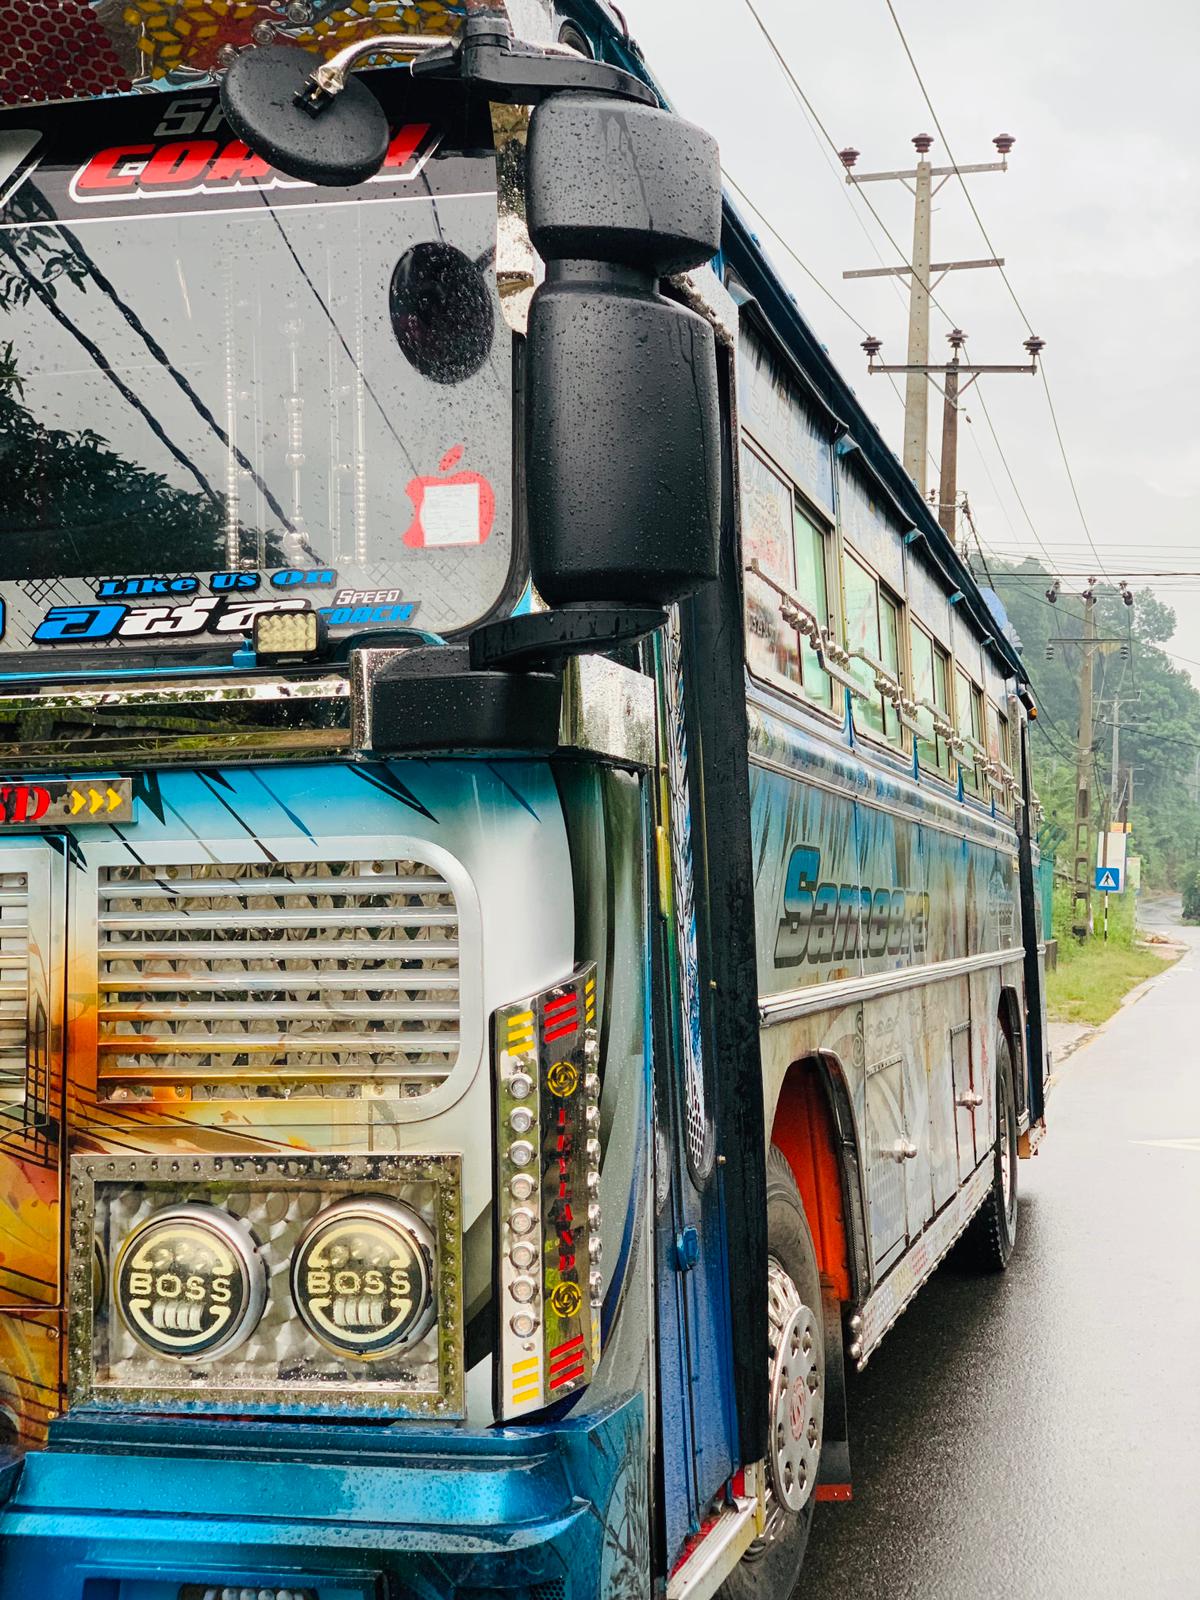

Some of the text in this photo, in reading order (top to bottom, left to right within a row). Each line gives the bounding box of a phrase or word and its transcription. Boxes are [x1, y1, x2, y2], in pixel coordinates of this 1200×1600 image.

[79, 122, 432, 189] COA
[129, 1272, 232, 1302] BOSS
[307, 1270, 411, 1295] BOSS
